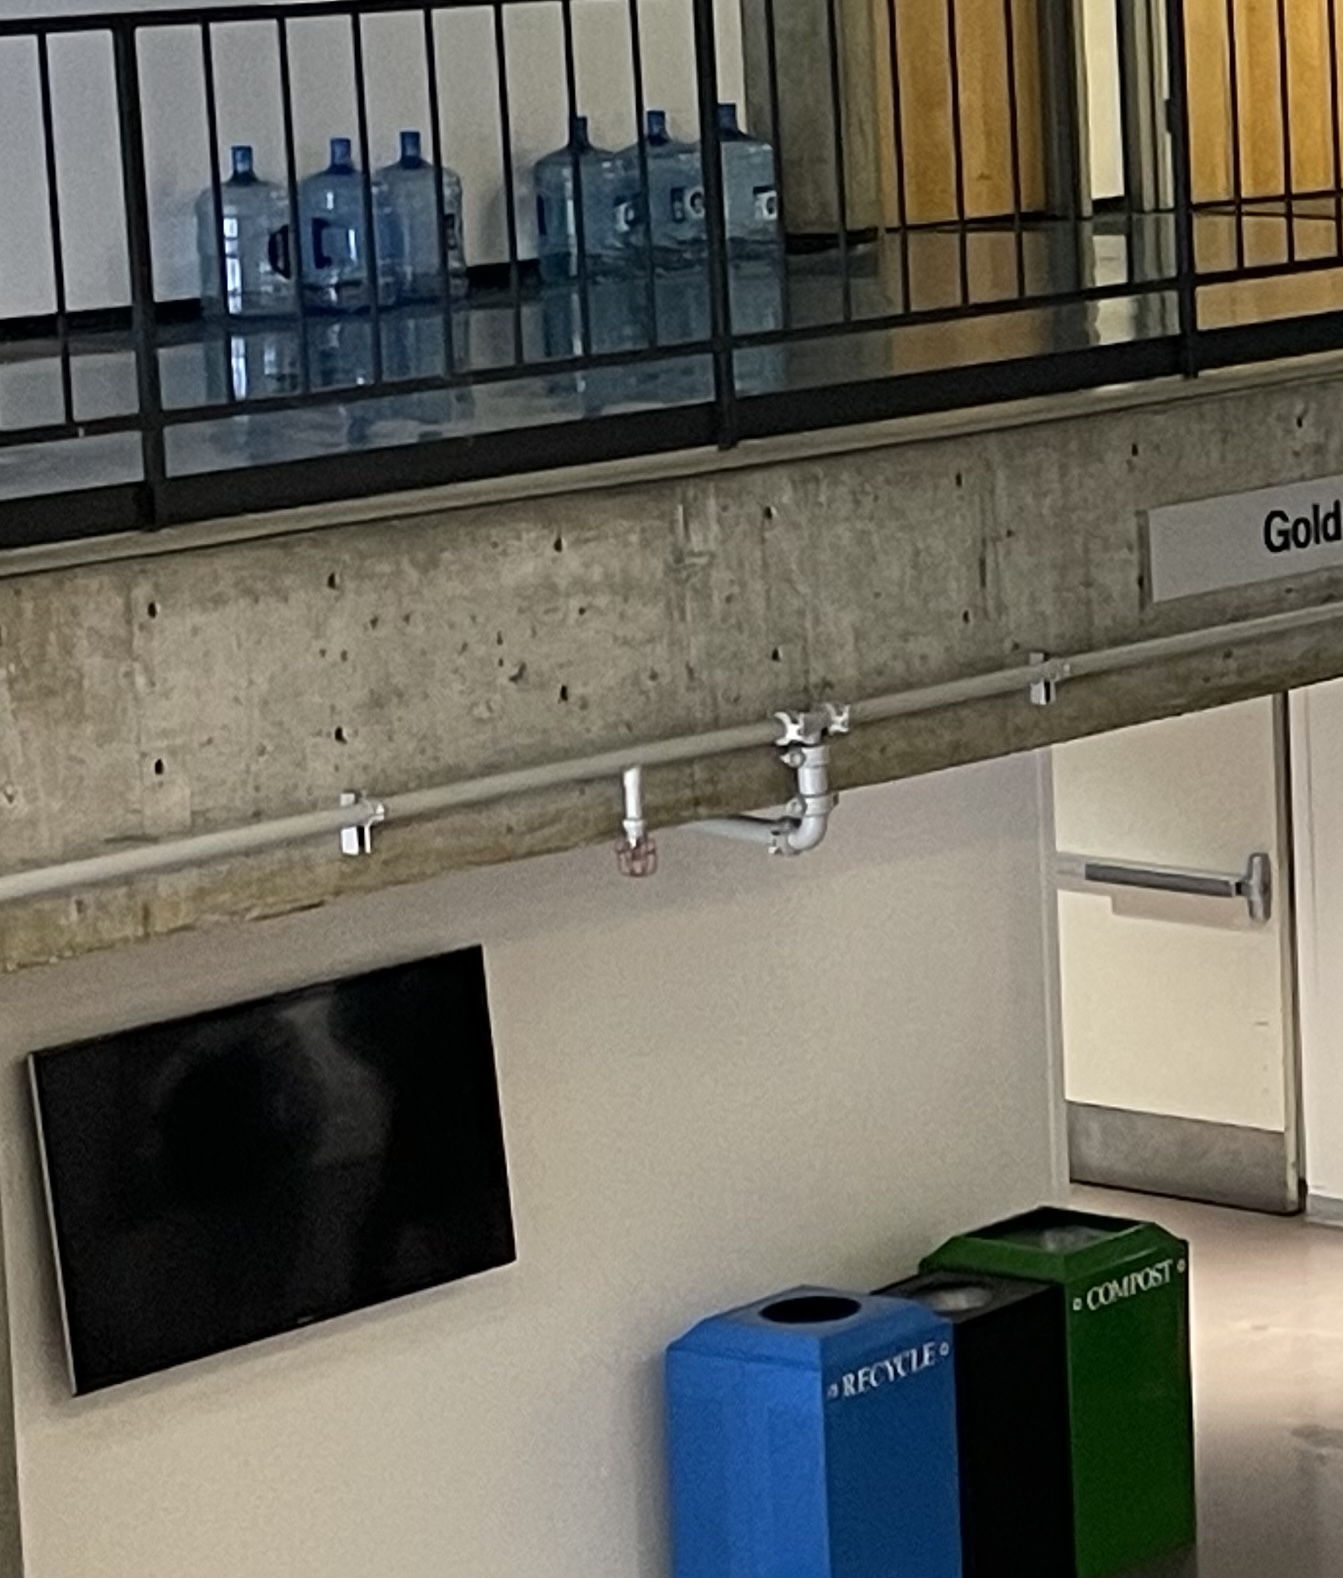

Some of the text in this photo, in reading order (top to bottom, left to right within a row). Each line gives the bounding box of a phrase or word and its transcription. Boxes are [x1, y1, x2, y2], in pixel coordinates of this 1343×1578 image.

[1262, 499, 1343, 554] Gold
[1086, 1258, 1174, 1312] COMPOST
[841, 1341, 937, 1397] RECYCLE
